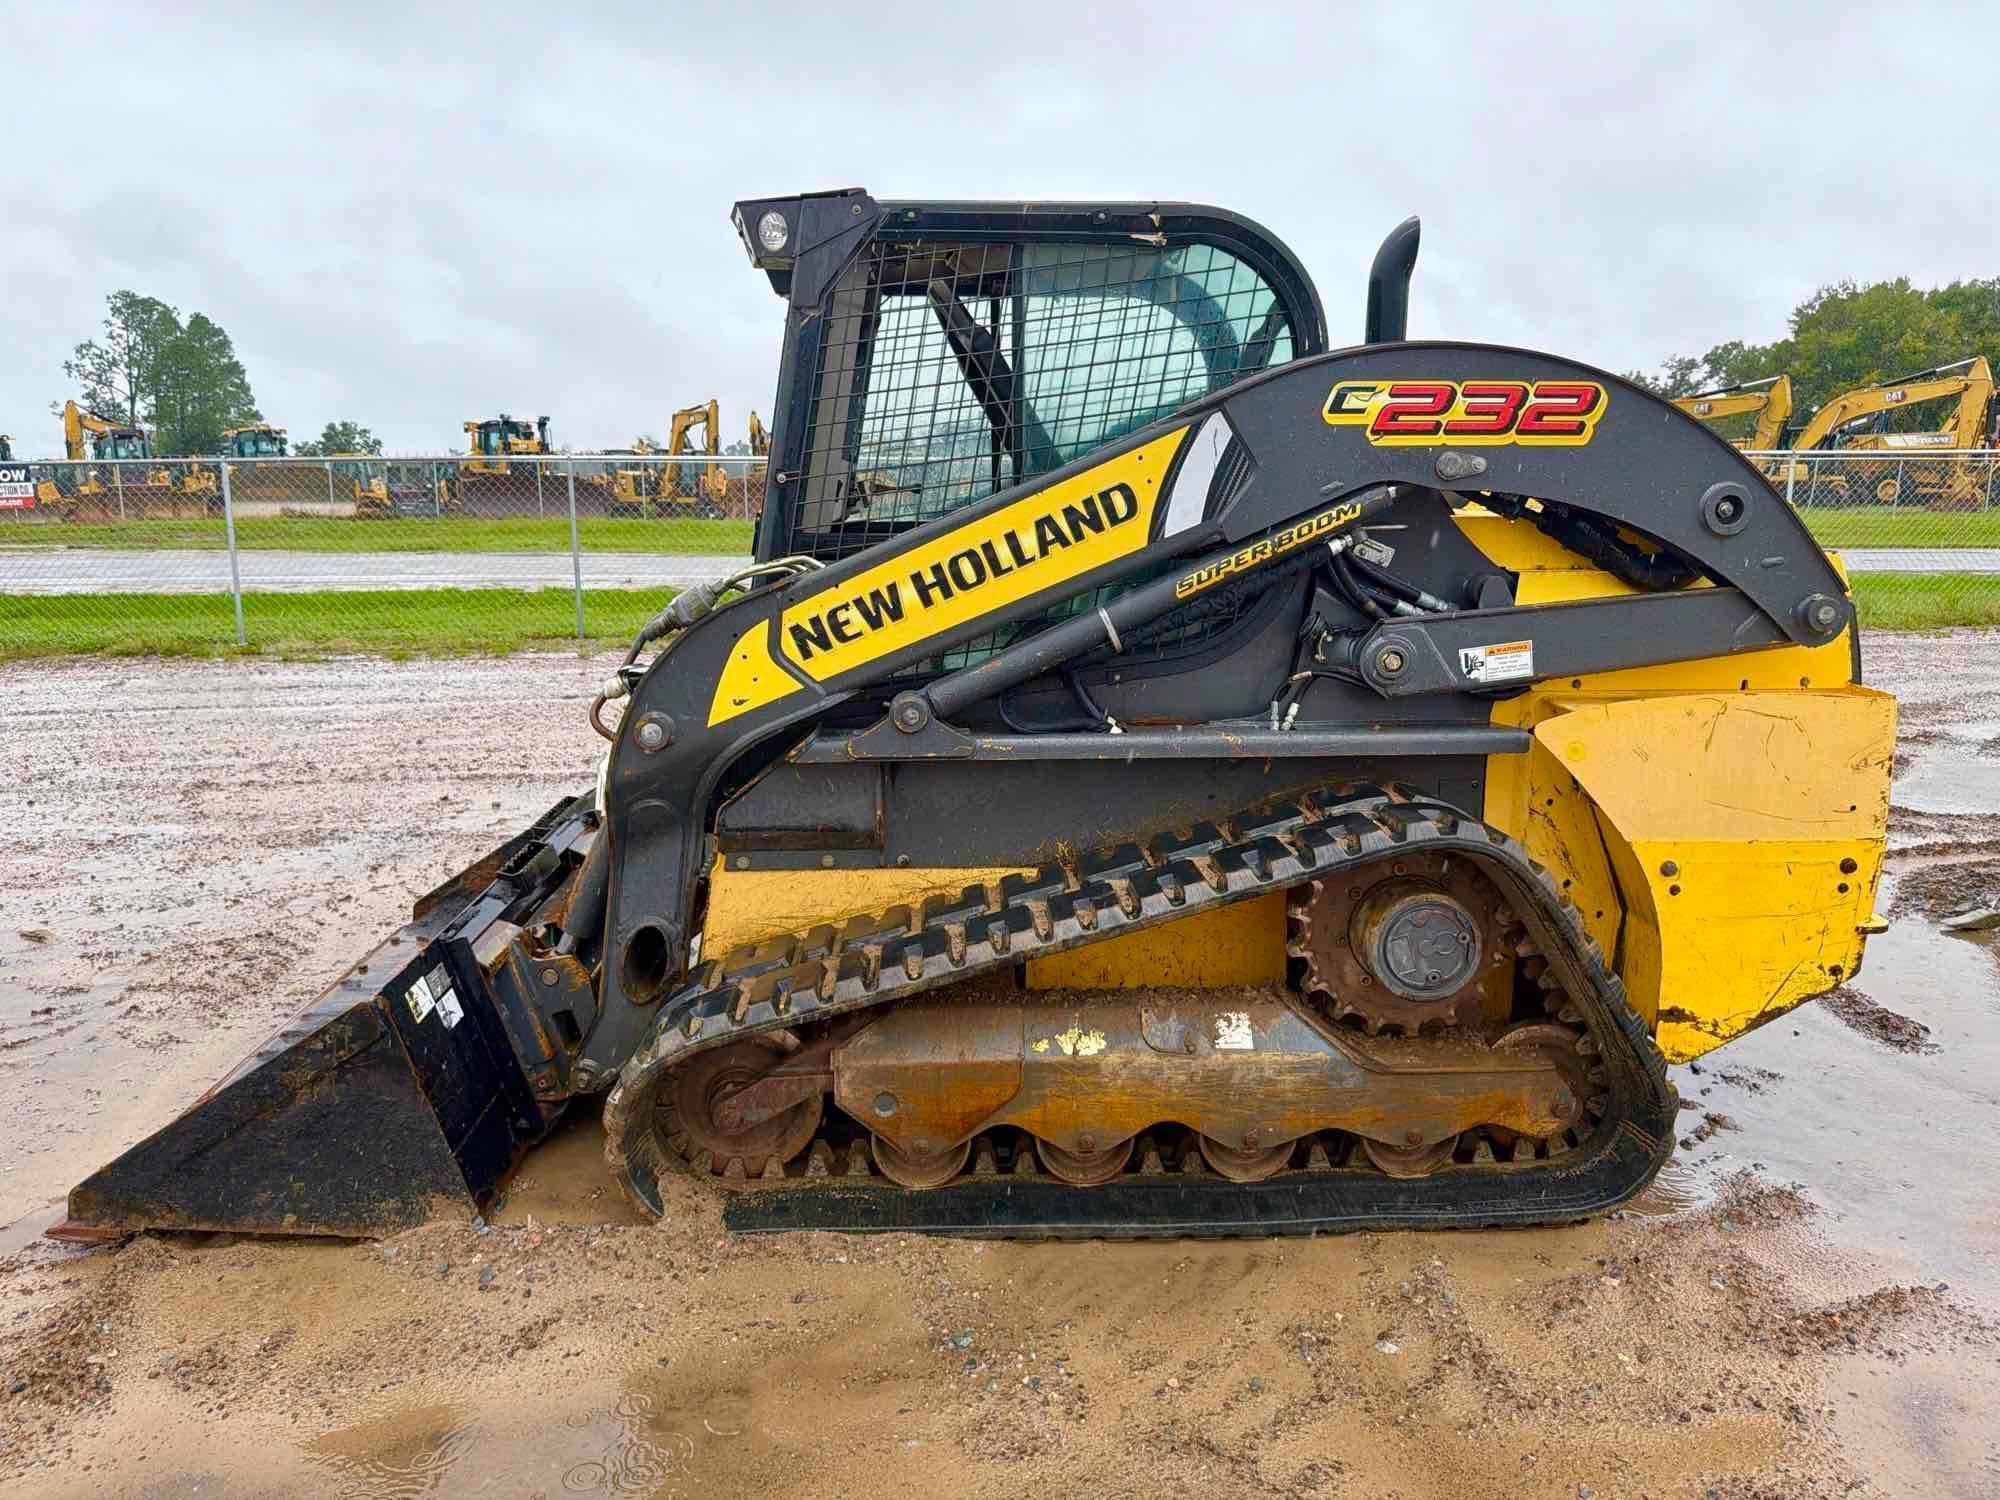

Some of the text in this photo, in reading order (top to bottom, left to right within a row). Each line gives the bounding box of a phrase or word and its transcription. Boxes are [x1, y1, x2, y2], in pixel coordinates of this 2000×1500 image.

[788, 482, 1139, 661] NEW HOLLAND
[1176, 503, 1362, 599] SUPER BOOM
